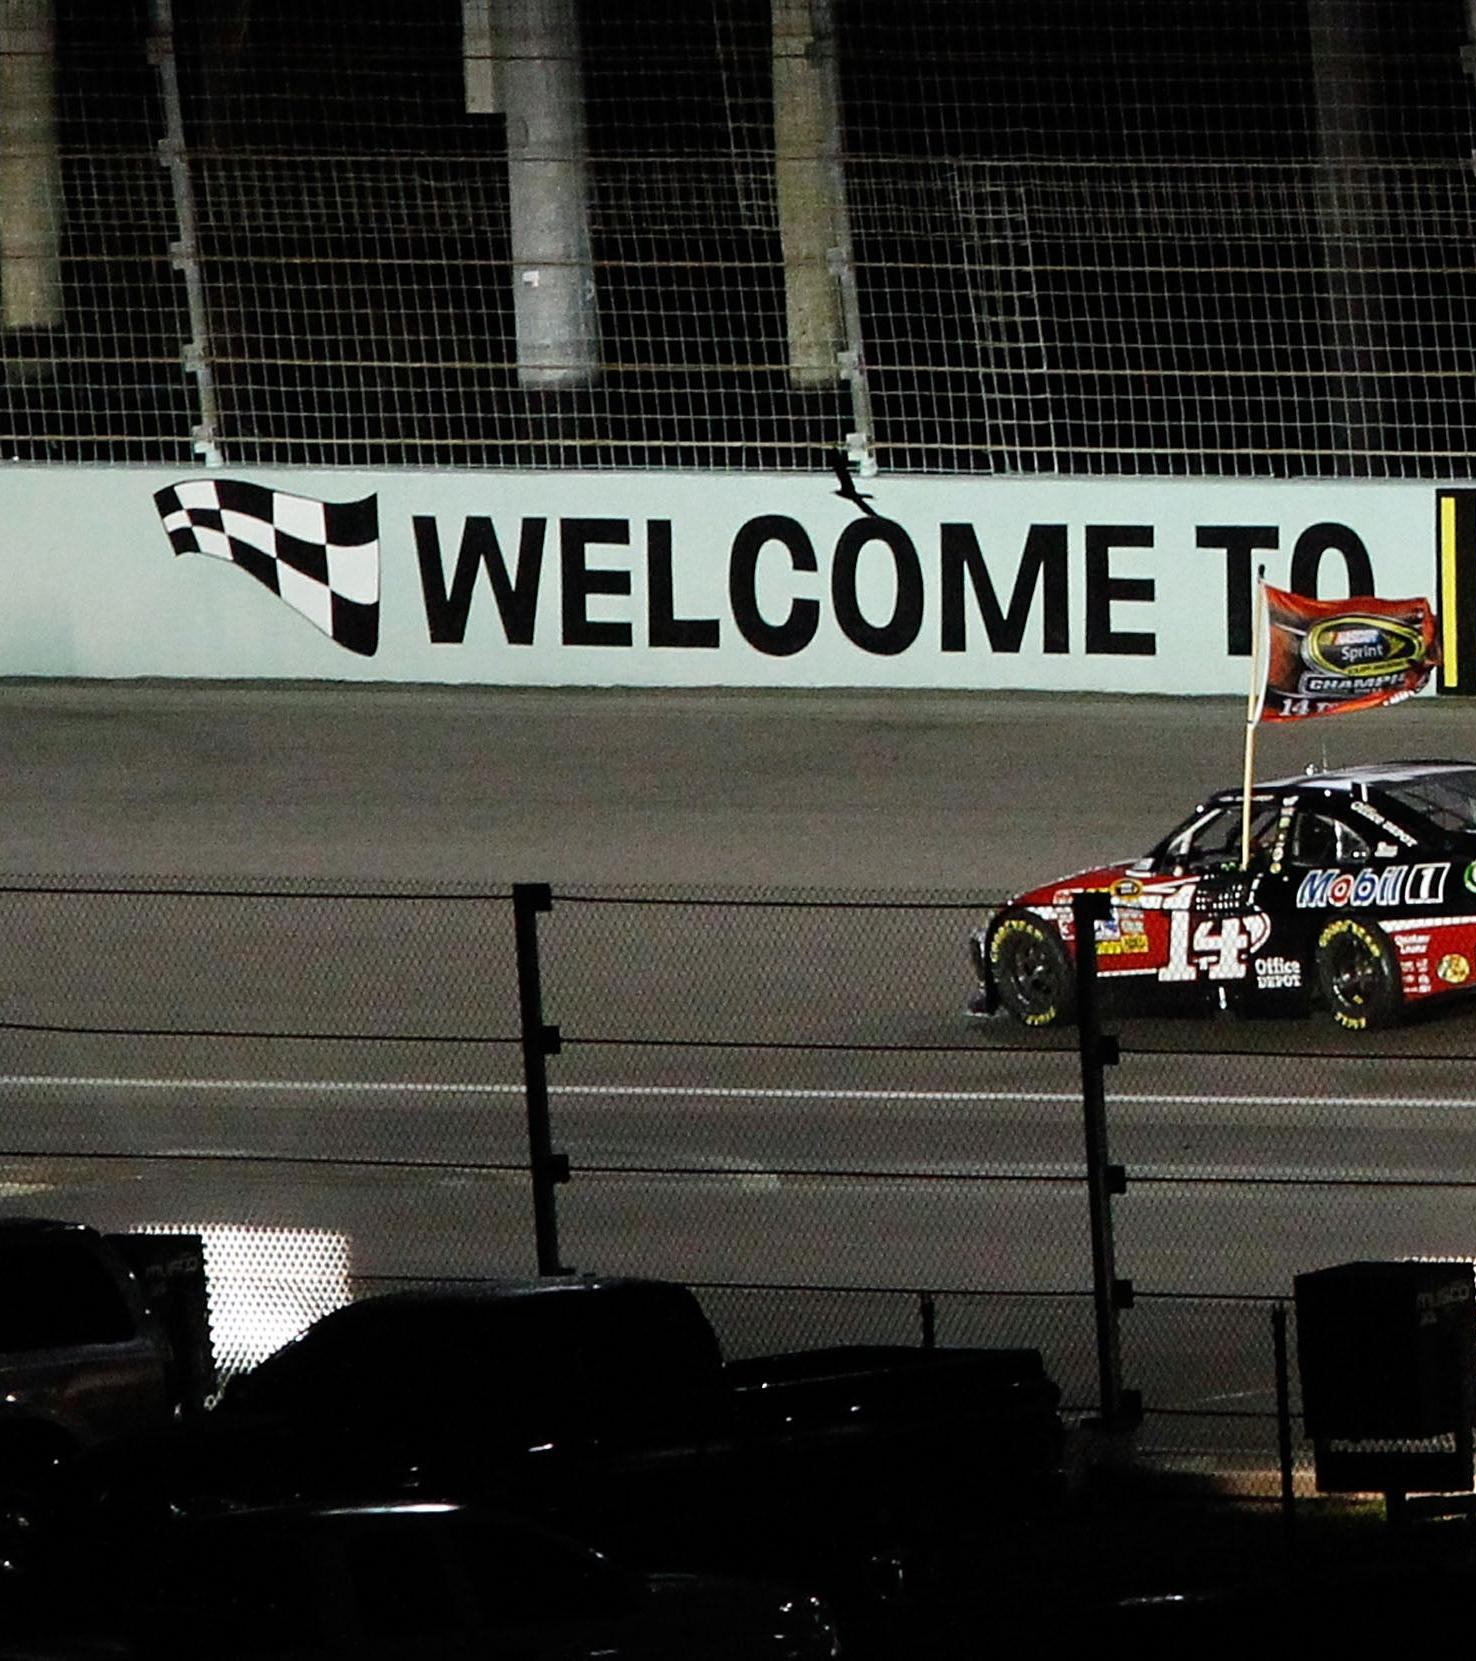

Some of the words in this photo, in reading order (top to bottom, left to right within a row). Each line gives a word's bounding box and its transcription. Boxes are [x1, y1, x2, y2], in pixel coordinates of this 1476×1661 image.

[412, 514, 1157, 657] WELCOME
[1196, 522, 1376, 656] TO
[1341, 645, 1384, 662] Sprint
[1279, 699, 1310, 716] 14
[1296, 867, 1409, 908] Mobil
[1157, 884, 1249, 982] 14
[1254, 957, 1301, 976] Office
[1256, 975, 1302, 989] DEPOT
